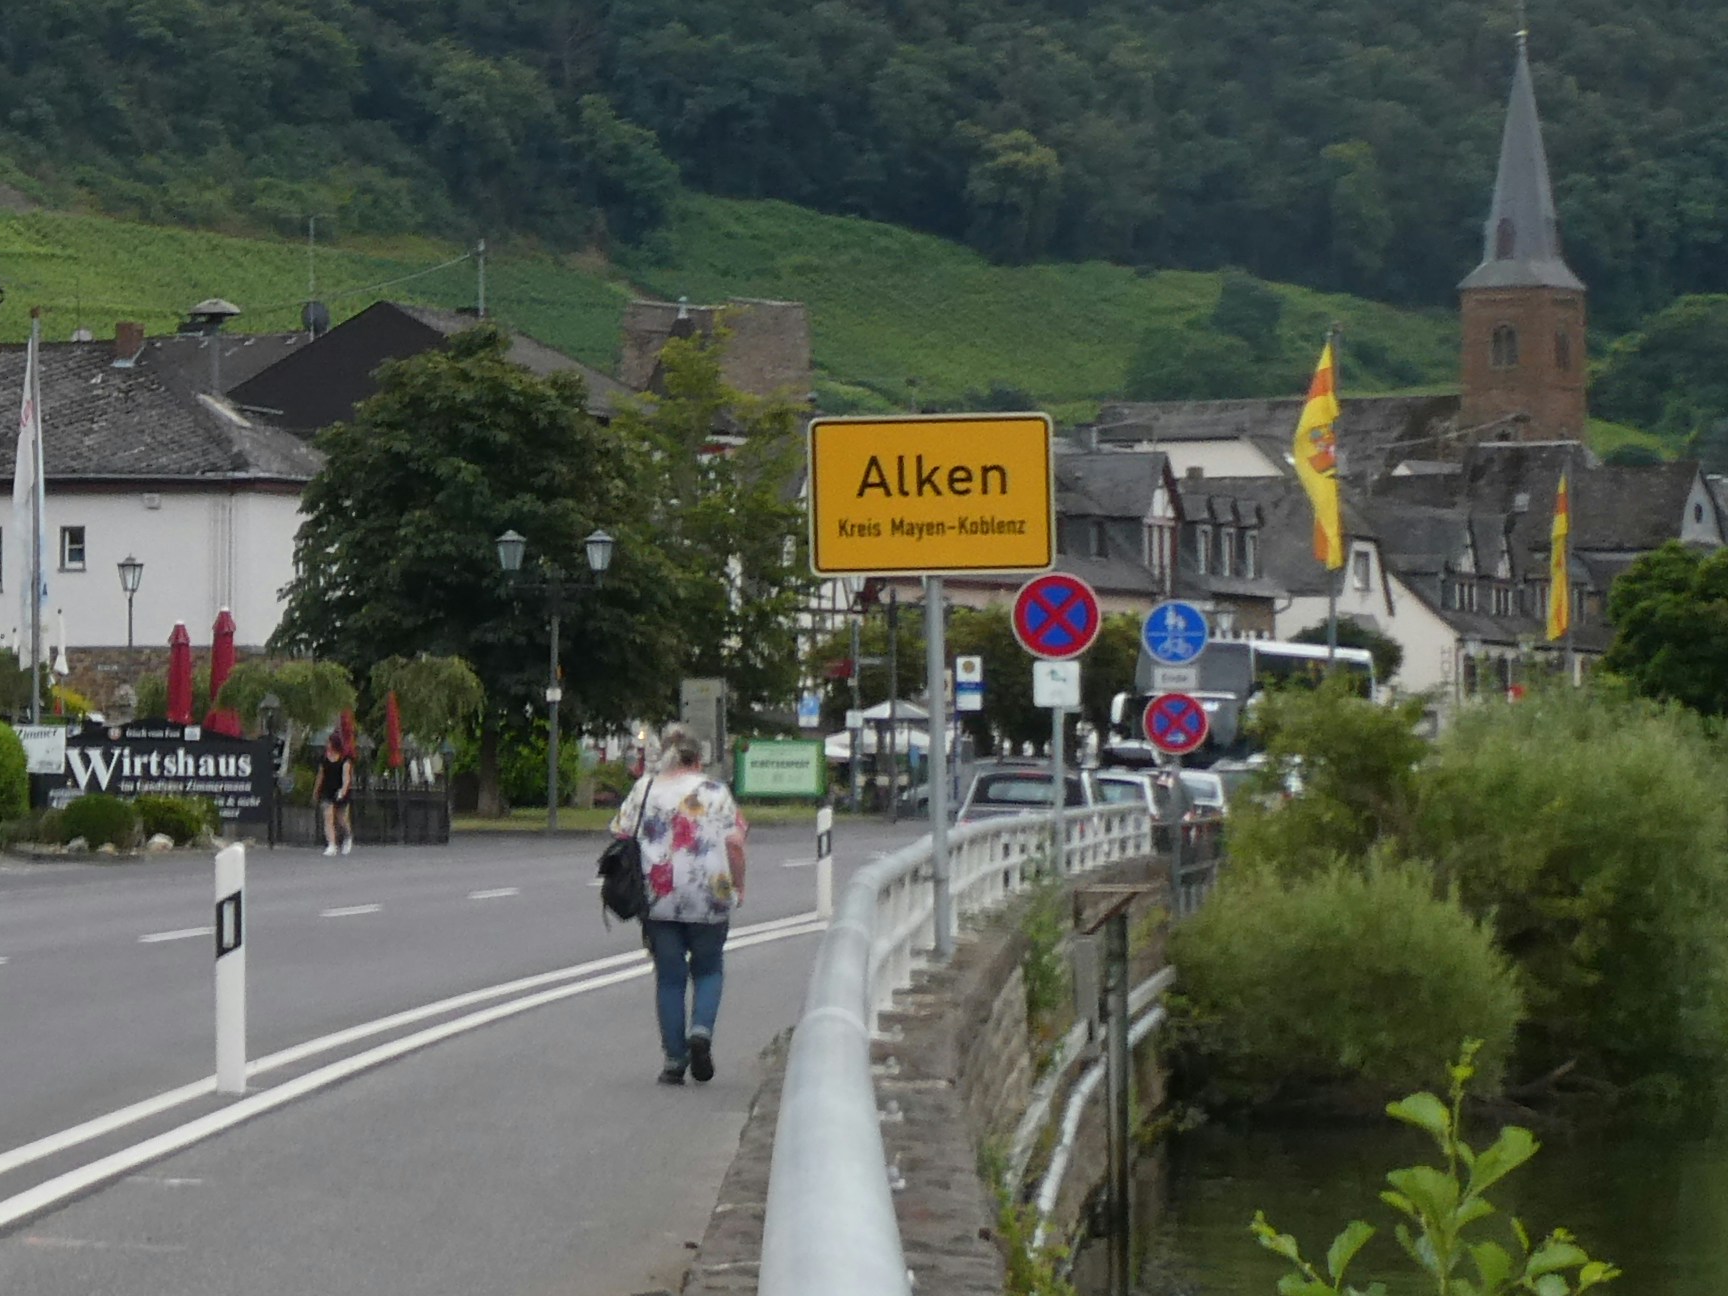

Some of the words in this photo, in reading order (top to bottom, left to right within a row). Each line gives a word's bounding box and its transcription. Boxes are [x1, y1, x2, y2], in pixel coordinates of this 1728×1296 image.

[856, 453, 1007, 499] Alken
[838, 517, 882, 539] Kreis
[890, 515, 1027, 542] Mayen-Koblenz
[65, 745, 253, 792] Wirtshaus
[185, 778, 253, 793] Zimmermann
